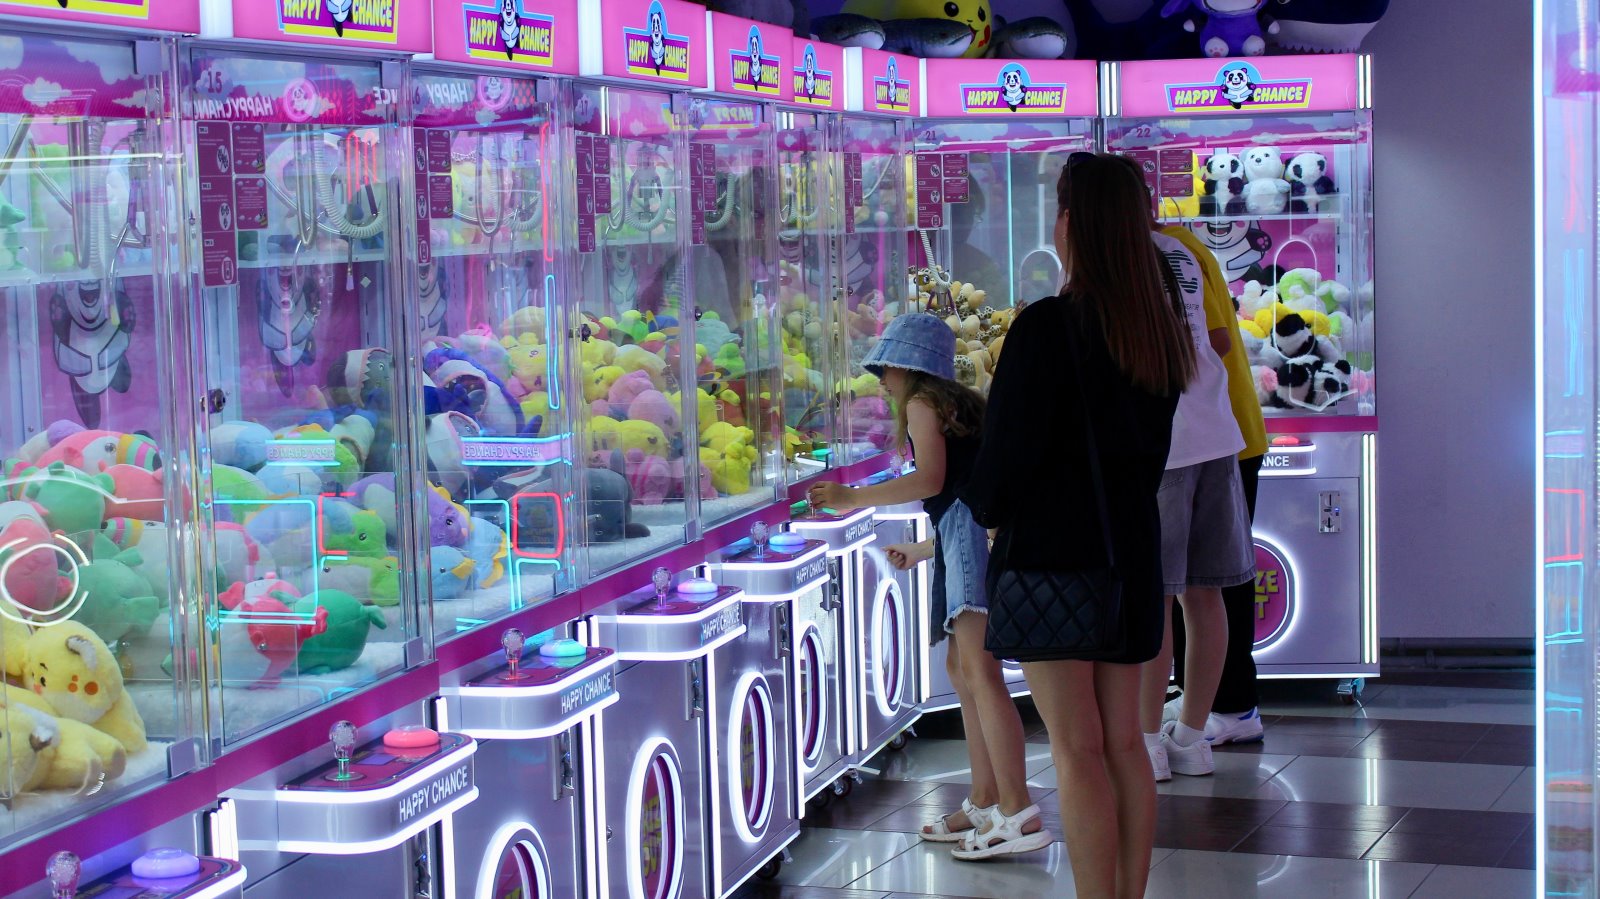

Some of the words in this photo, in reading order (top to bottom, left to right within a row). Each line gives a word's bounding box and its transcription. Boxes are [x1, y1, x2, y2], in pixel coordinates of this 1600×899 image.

[283, 0, 321, 21] HAPPY
[352, 0, 393, 27] CHANCE
[469, 16, 498, 47] HAPPY
[519, 24, 551, 53] CHANCE
[629, 38, 650, 65] HAPPY
[664, 44, 687, 70] CHANCE
[207, 71, 223, 94] 15
[734, 59, 750, 81] HAPPY
[761, 63, 779, 85] CHANCE
[967, 90, 1000, 106] HAPPY
[1025, 90, 1062, 107] CHANCE
[1174, 88, 1218, 106] HAPPY
[1253, 86, 1304, 103] CHANCE
[925, 130, 936, 140] 21
[1136, 127, 1151, 138] 22
[845, 527, 858, 543] HAPPY
[796, 567, 810, 584] HAPPY
[561, 687, 584, 715] HAPPY
[584, 671, 612, 702] CHANCE
[399, 790, 430, 823] HAPPY
[431, 765, 468, 804] CHANCE
